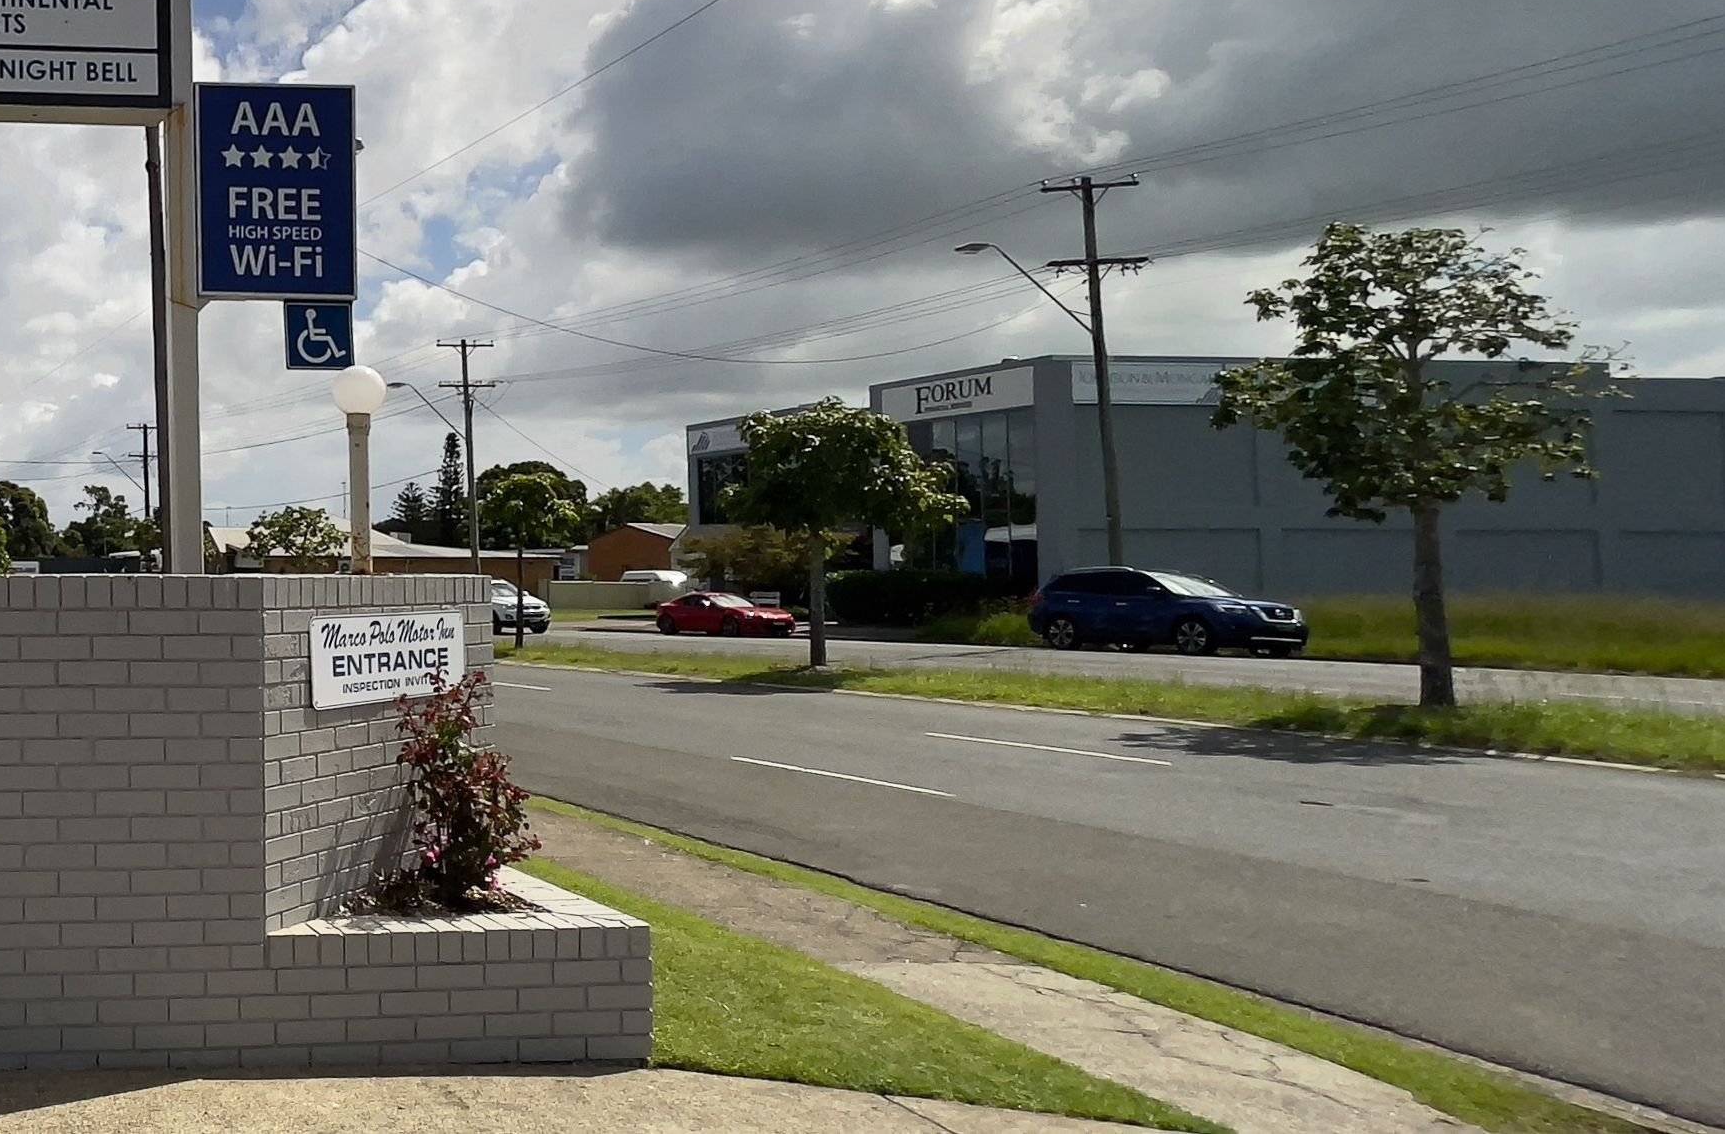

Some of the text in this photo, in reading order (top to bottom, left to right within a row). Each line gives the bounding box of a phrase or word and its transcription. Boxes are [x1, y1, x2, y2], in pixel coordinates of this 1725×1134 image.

[86, 62, 138, 83] BELL
[230, 101, 320, 137] AAA
[228, 186, 322, 220] FREE
[228, 225, 322, 241] HIGH SPEED
[230, 244, 323, 278] Wi-Fi
[915, 376, 994, 415] FORUM
[321, 617, 455, 649] Marco Polo Motor Inn
[332, 647, 449, 677] ENTRANCE
[342, 678, 401, 694] INSPECTION
